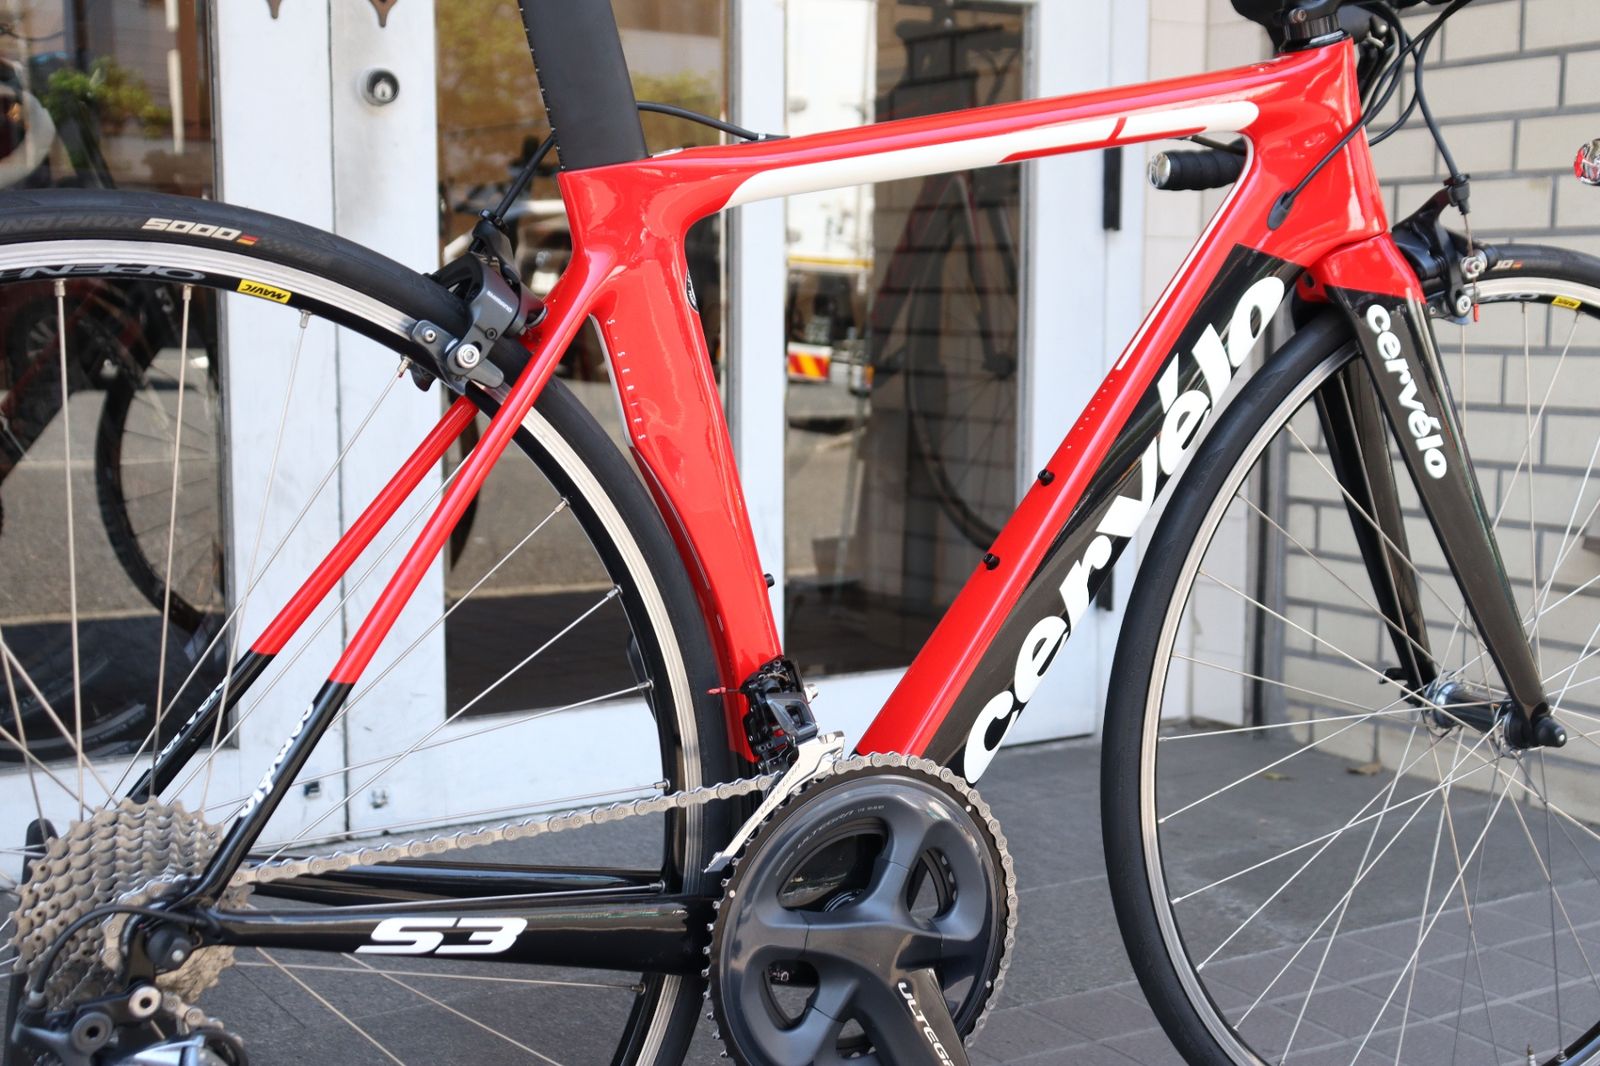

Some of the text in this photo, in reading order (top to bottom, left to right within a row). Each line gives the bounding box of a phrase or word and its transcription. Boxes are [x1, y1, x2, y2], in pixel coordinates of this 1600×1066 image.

[142, 218, 242, 241] 5000
[20, 264, 206, 280] OPEN
[241, 283, 287, 300] MAVIC
[353, 917, 528, 954] S3
